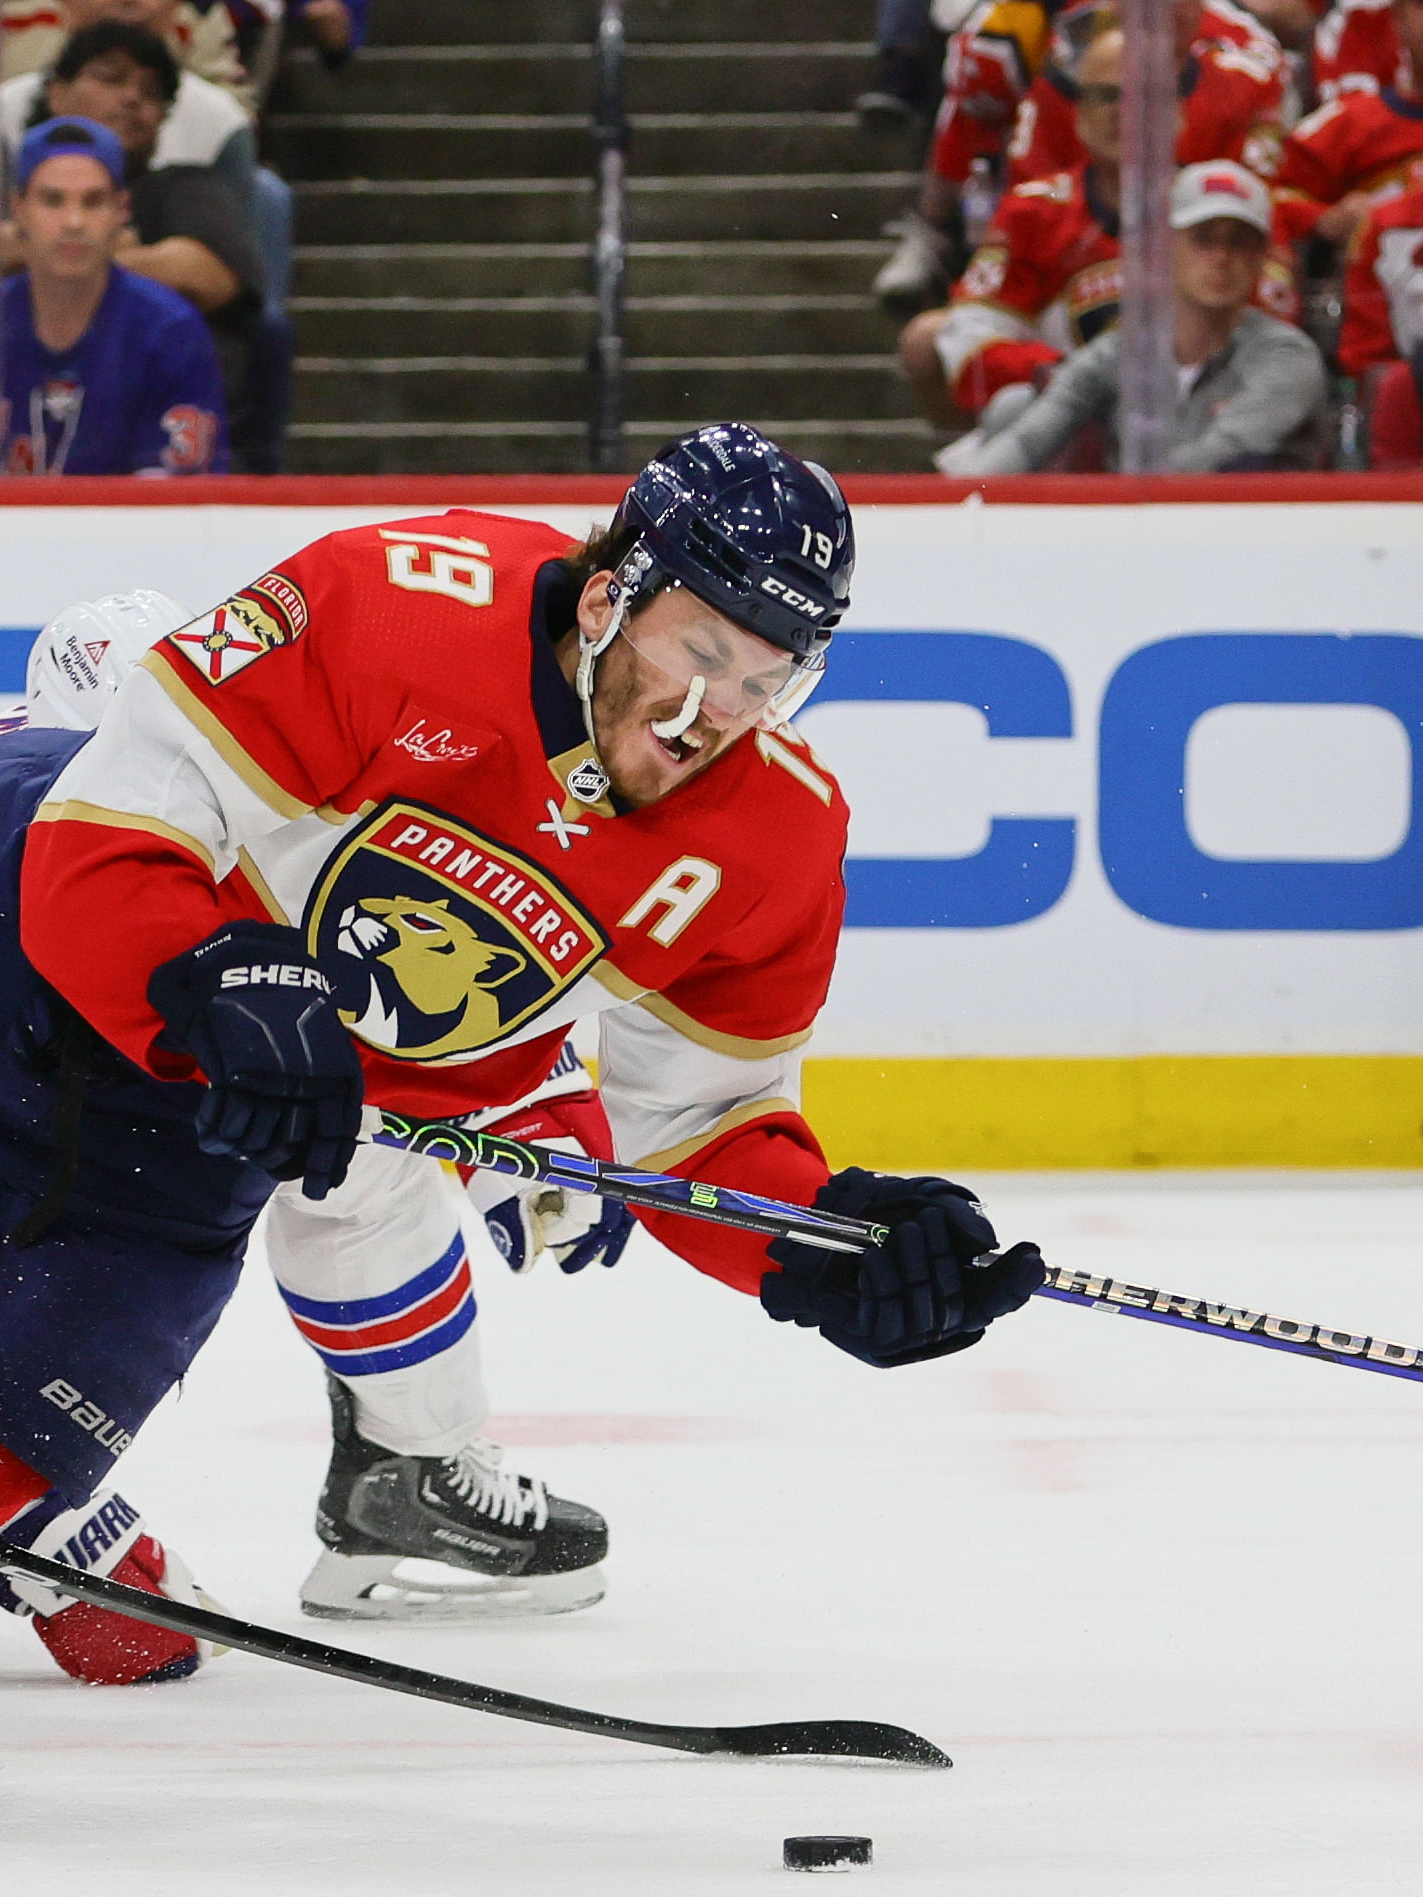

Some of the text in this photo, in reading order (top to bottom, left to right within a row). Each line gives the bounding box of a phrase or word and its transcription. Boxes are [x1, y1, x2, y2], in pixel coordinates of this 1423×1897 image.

[378, 527, 494, 608] 19
[800, 523, 834, 570] 19
[263, 578, 306, 628] FLORIDA
[760, 575, 827, 618] CCM
[59, 652, 85, 693] Moore
[65, 635, 99, 690] Benjamin
[390, 823, 581, 964] PANTHERS
[617, 854, 723, 949] A
[1044, 1258, 1419, 1369] HERWOOD
